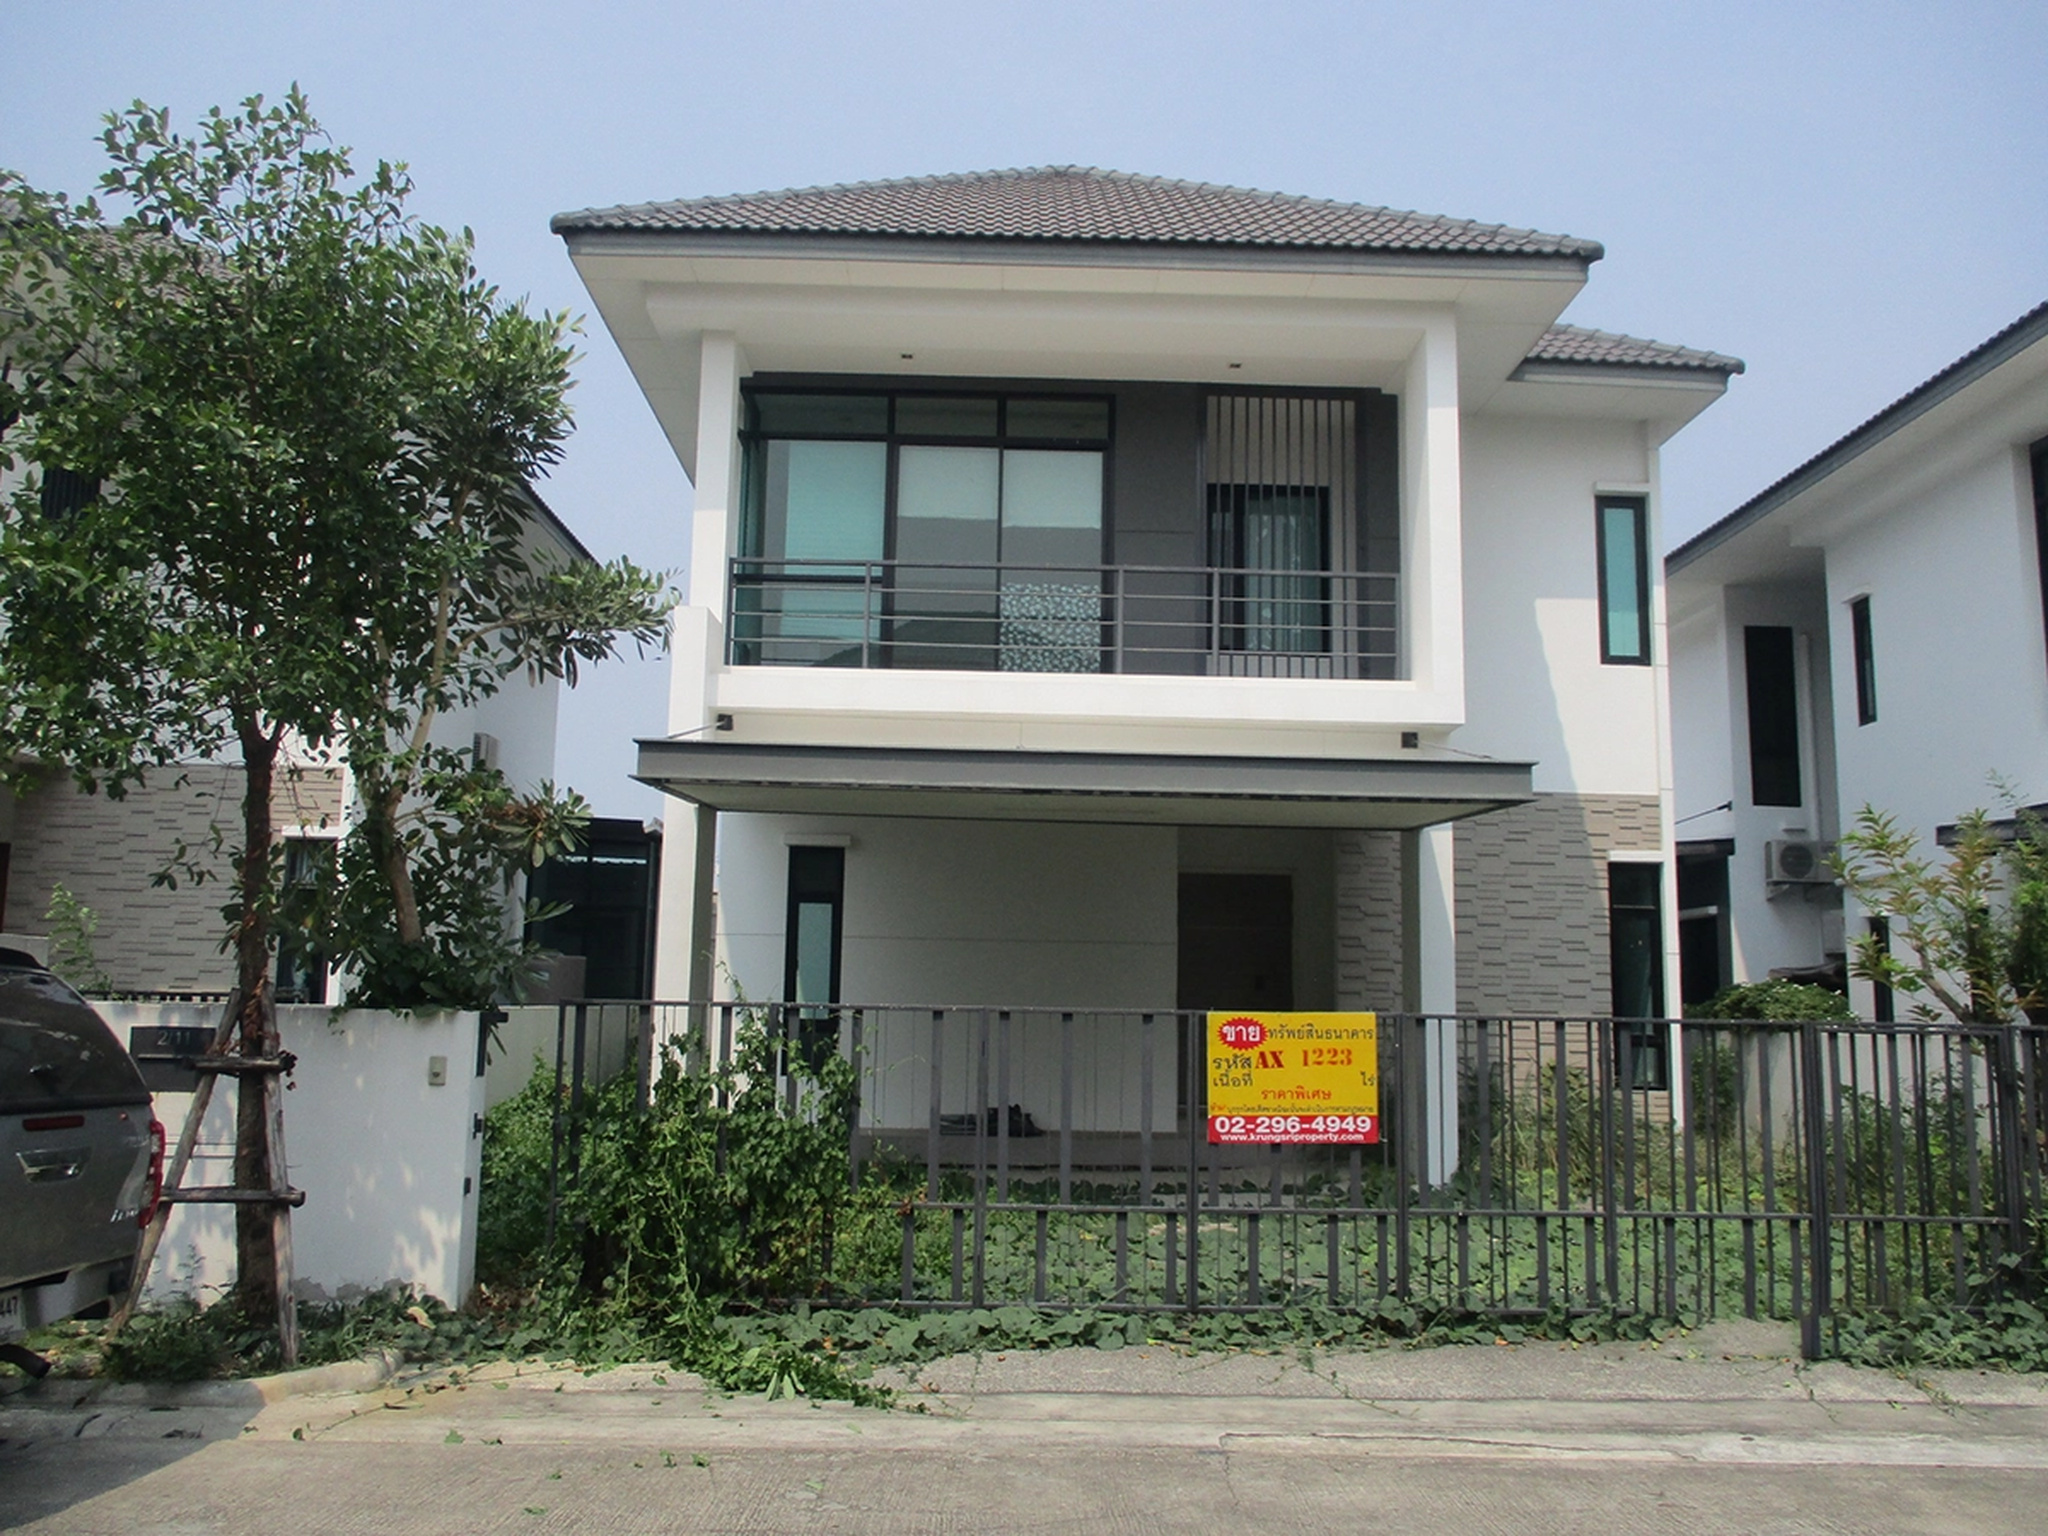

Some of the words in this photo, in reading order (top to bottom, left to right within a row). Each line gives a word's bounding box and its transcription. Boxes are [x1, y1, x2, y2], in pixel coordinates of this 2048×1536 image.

[157, 1030, 190, 1046] 2/11
[1221, 1025, 1261, 1041] ขาย
[1268, 1023, 1374, 1039] ทรัพย์สินธนาคาร
[1213, 1053, 1252, 1069] รหัส
[1255, 1050, 1284, 1069] AX
[1302, 1048, 1352, 1067] 1223
[1261, 1085, 1332, 1100] ราคาพิเศษ
[1214, 1115, 1372, 1133] 02-296-4949
[1220, 1132, 1365, 1143] www.krungsriproperty.com
